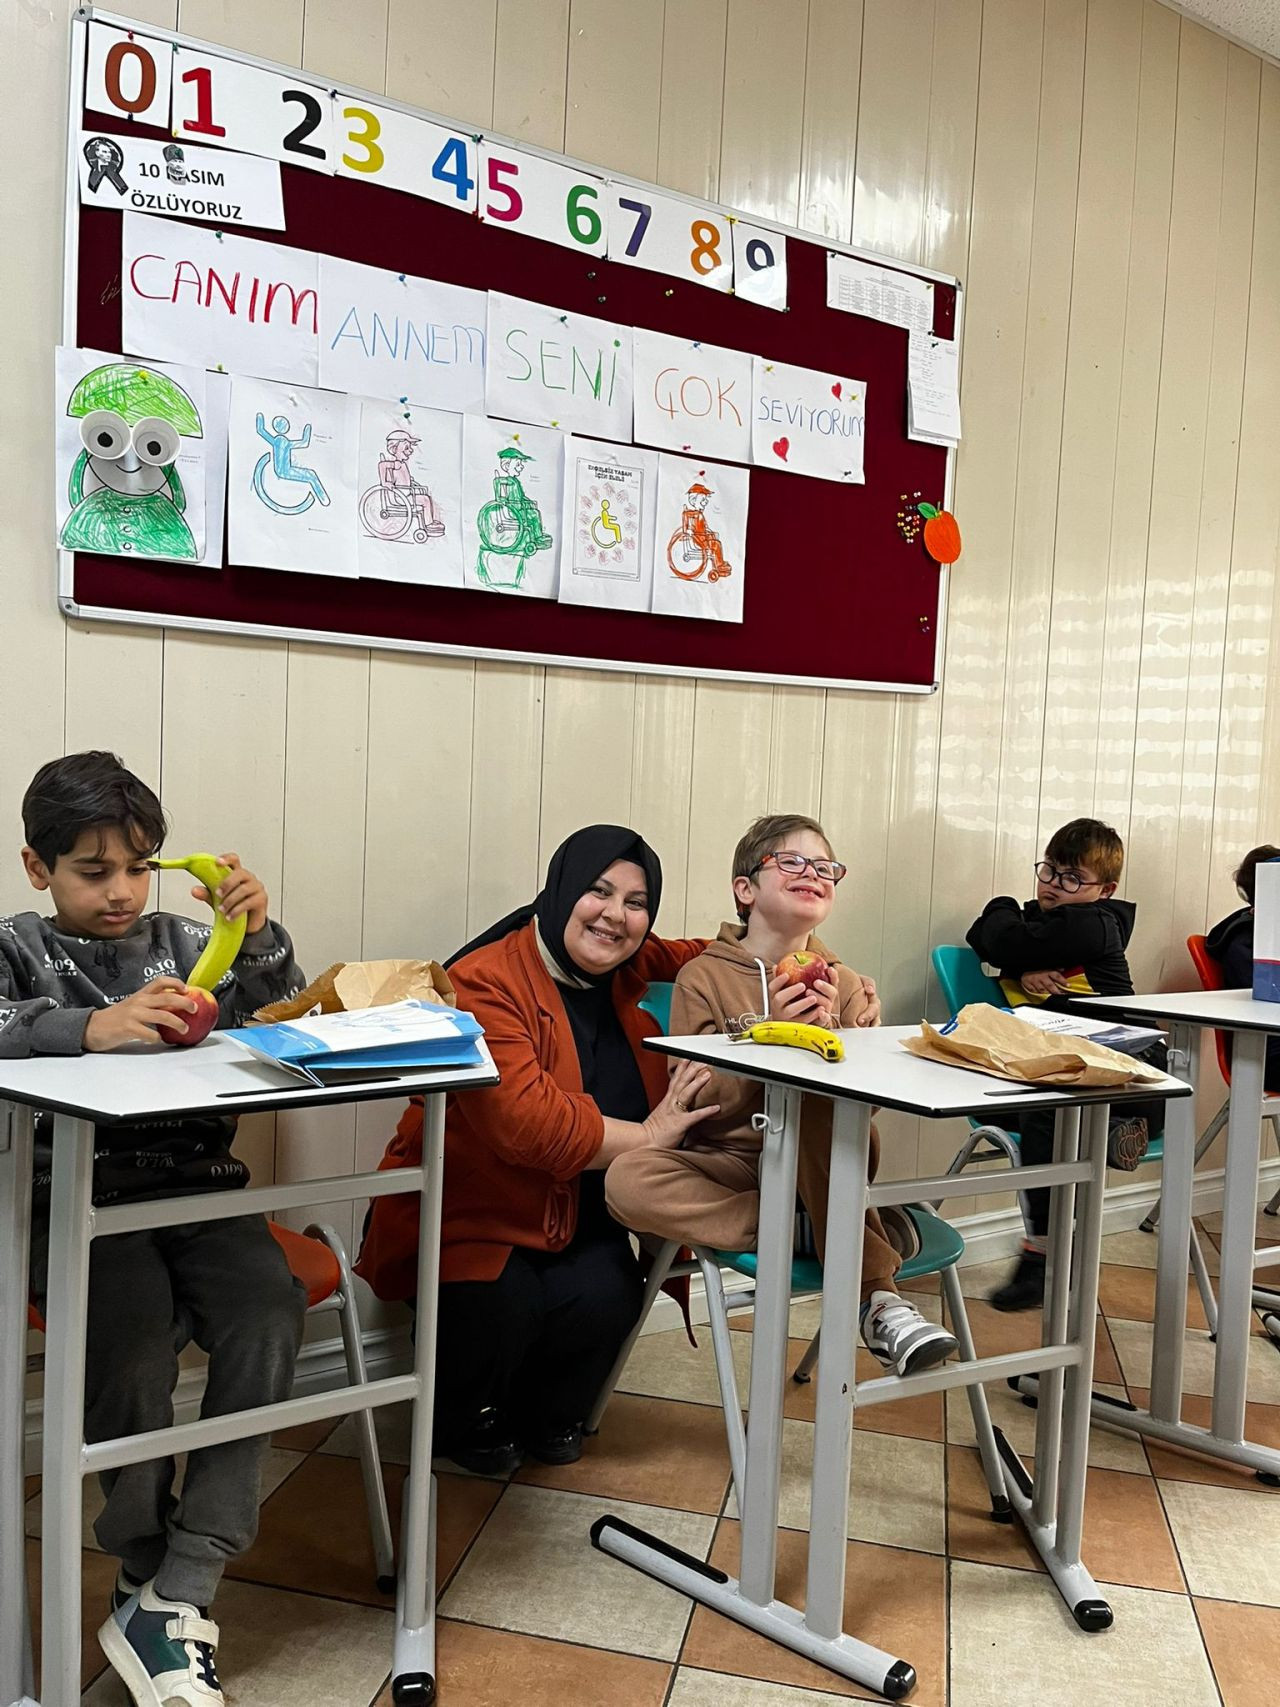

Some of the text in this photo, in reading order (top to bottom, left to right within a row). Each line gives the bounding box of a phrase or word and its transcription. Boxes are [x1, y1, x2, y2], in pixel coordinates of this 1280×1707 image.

[105, 42, 156, 113] 0
[182, 67, 226, 137] 1
[282, 90, 326, 160] 2
[342, 107, 384, 173] 3
[431, 137, 474, 200] 4
[487, 157, 523, 221] 5
[566, 185, 602, 245] 6
[619, 198, 651, 257] 7
[690, 219, 721, 276] 8
[131, 189, 243, 220] ÖZLÜYORUZ
[139, 162, 160, 178] 10
[130, 254, 318, 334] CANIM
[331, 306, 485, 368] ANNEM
[655, 367, 742, 426] ÇOK
